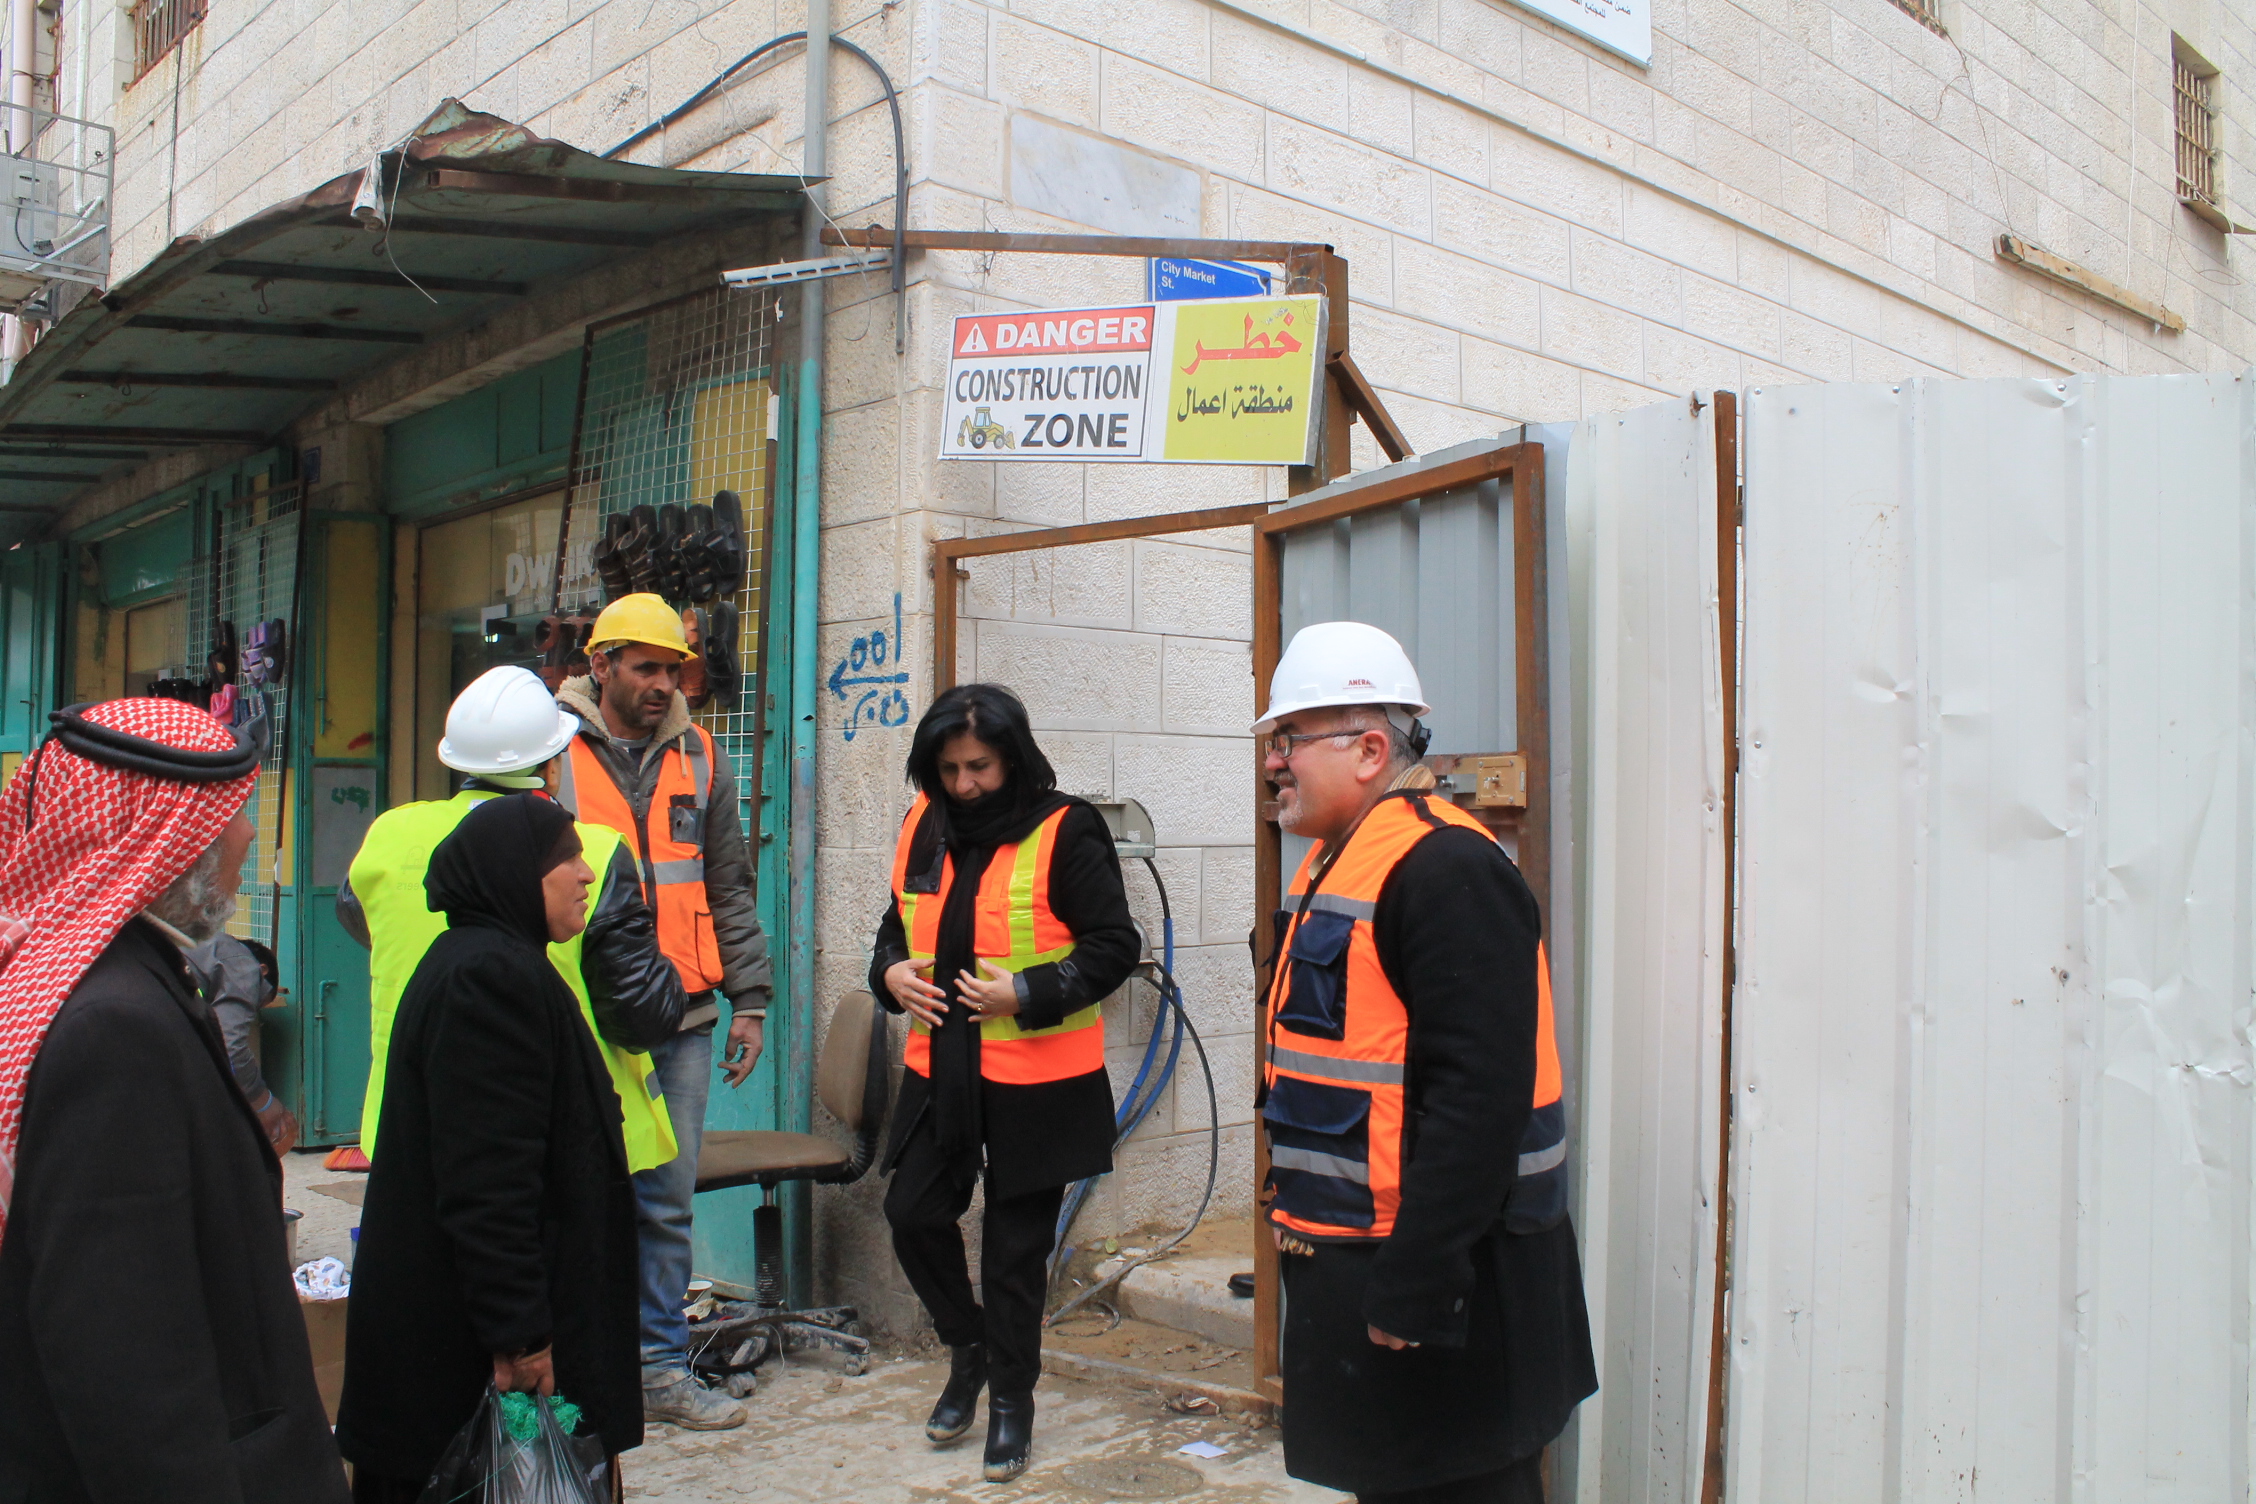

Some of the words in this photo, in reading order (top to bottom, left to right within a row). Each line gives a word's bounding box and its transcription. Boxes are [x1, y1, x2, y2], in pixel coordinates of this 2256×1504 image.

[1161, 260, 1181, 278] City
[1183, 267, 1216, 286] Market
[1161, 275, 1175, 290] St.
[995, 316, 1147, 349] DANGER
[1180, 312, 1303, 376] خطر
[955, 364, 1142, 403] CONSTRUCTION
[1232, 384, 1293, 420] منطقة
[1021, 413, 1129, 448] ZONE
